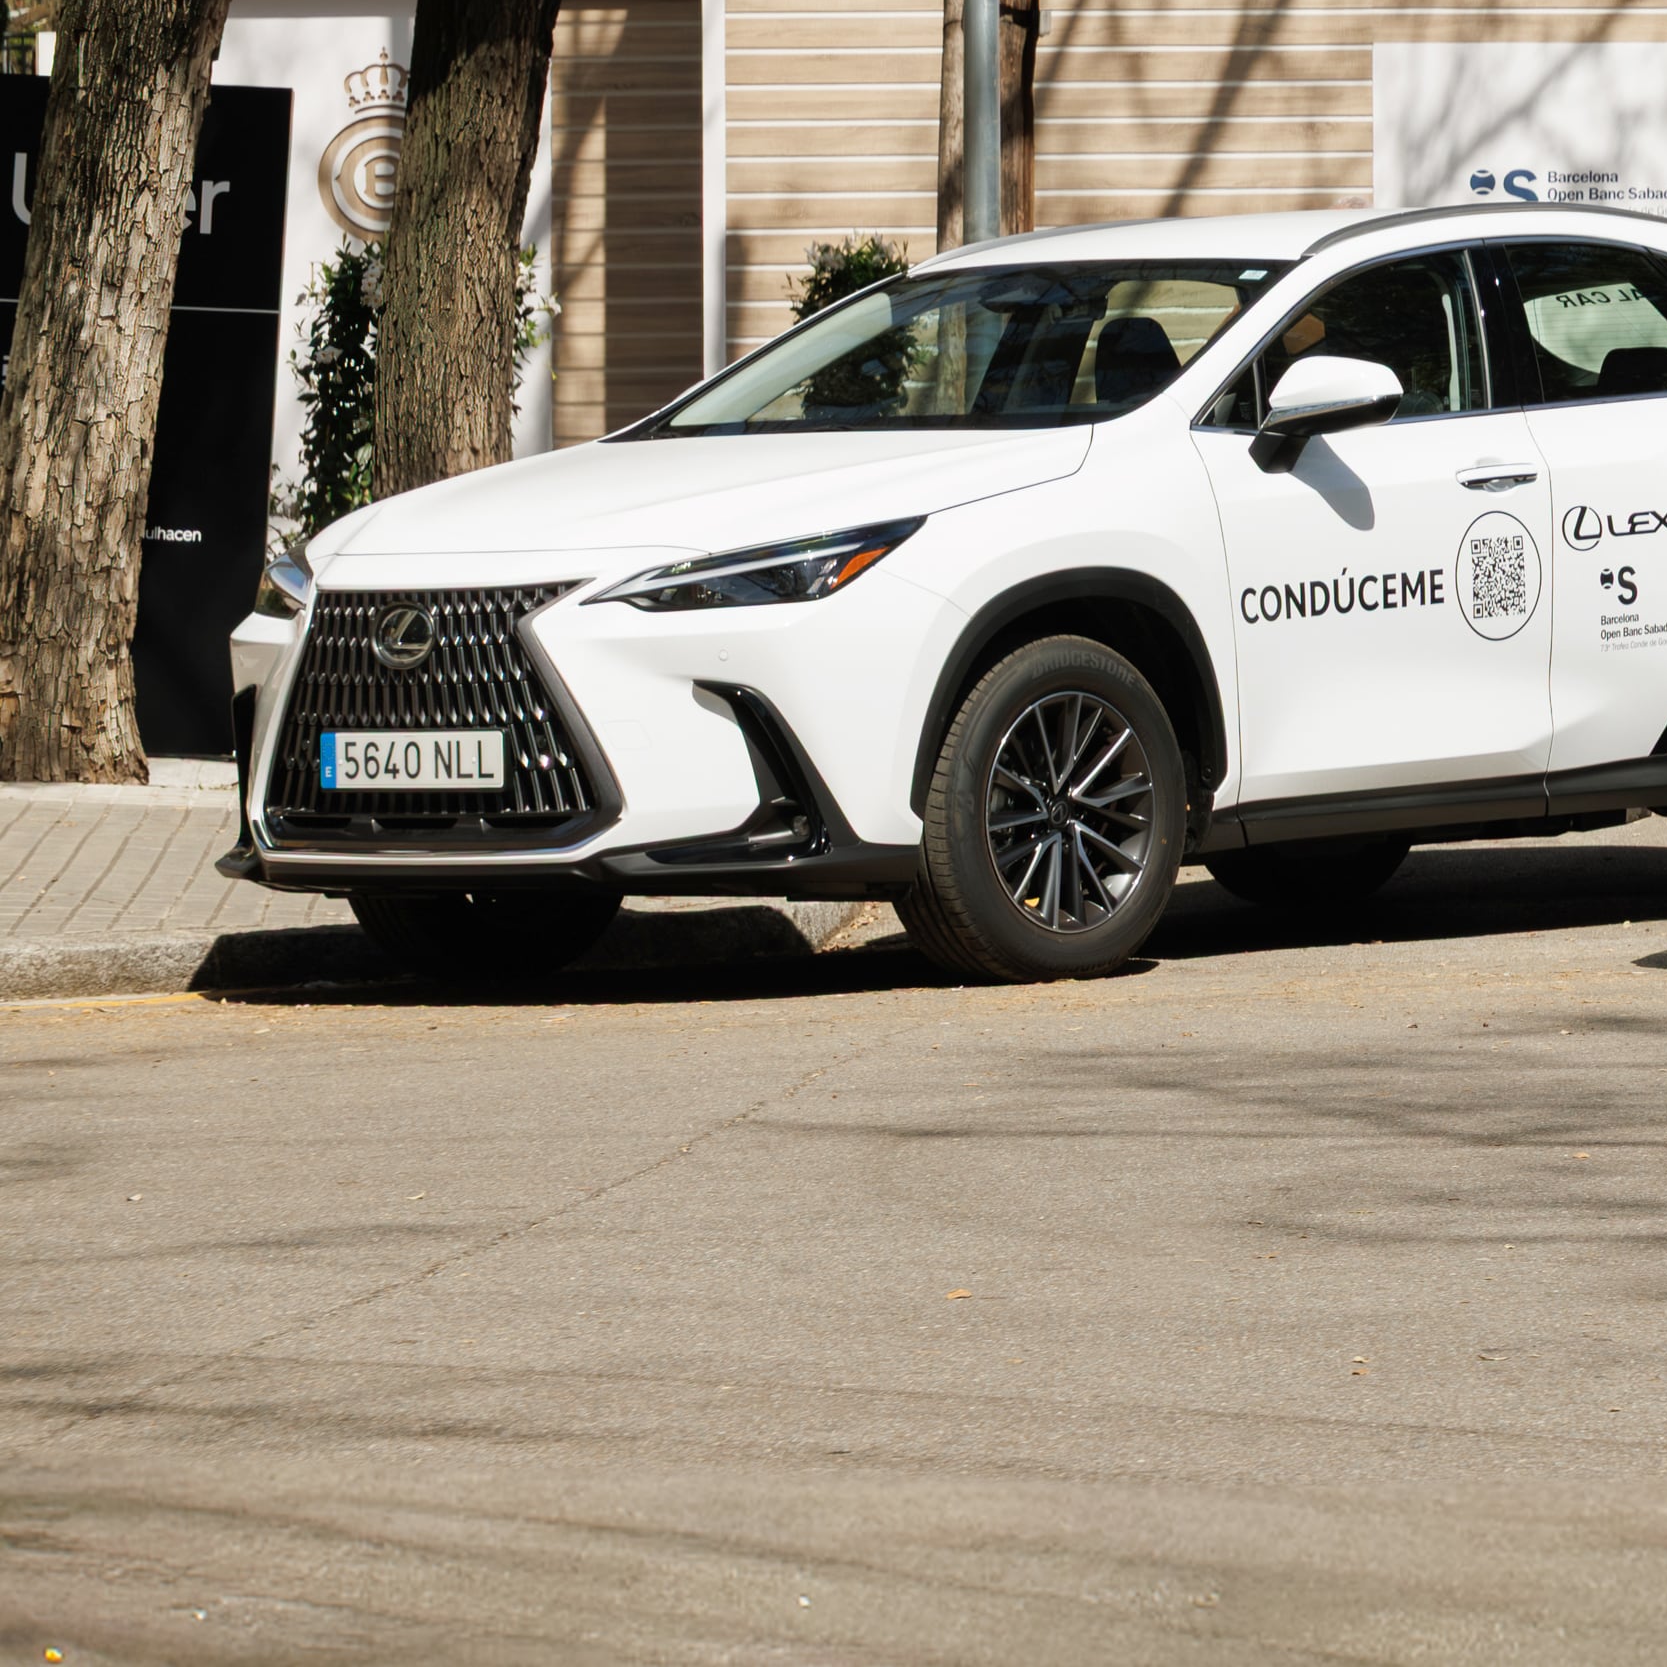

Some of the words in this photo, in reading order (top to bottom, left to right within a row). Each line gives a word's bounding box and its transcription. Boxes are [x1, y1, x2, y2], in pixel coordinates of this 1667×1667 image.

[1547, 170, 1618, 183] Barcelona
[1547, 188, 1584, 203] Open
[1588, 187, 1624, 201] Banc
[143, 526, 202, 543] ulhacen
[1240, 567, 1445, 624] CONDÚCEME
[1600, 613, 1639, 626] Barcelona
[1600, 629, 1621, 641] Open
[1622, 626, 1643, 638] Banc
[325, 766, 333, 778] E
[344, 741, 421, 779] 5640
[434, 740, 494, 779] NLL
